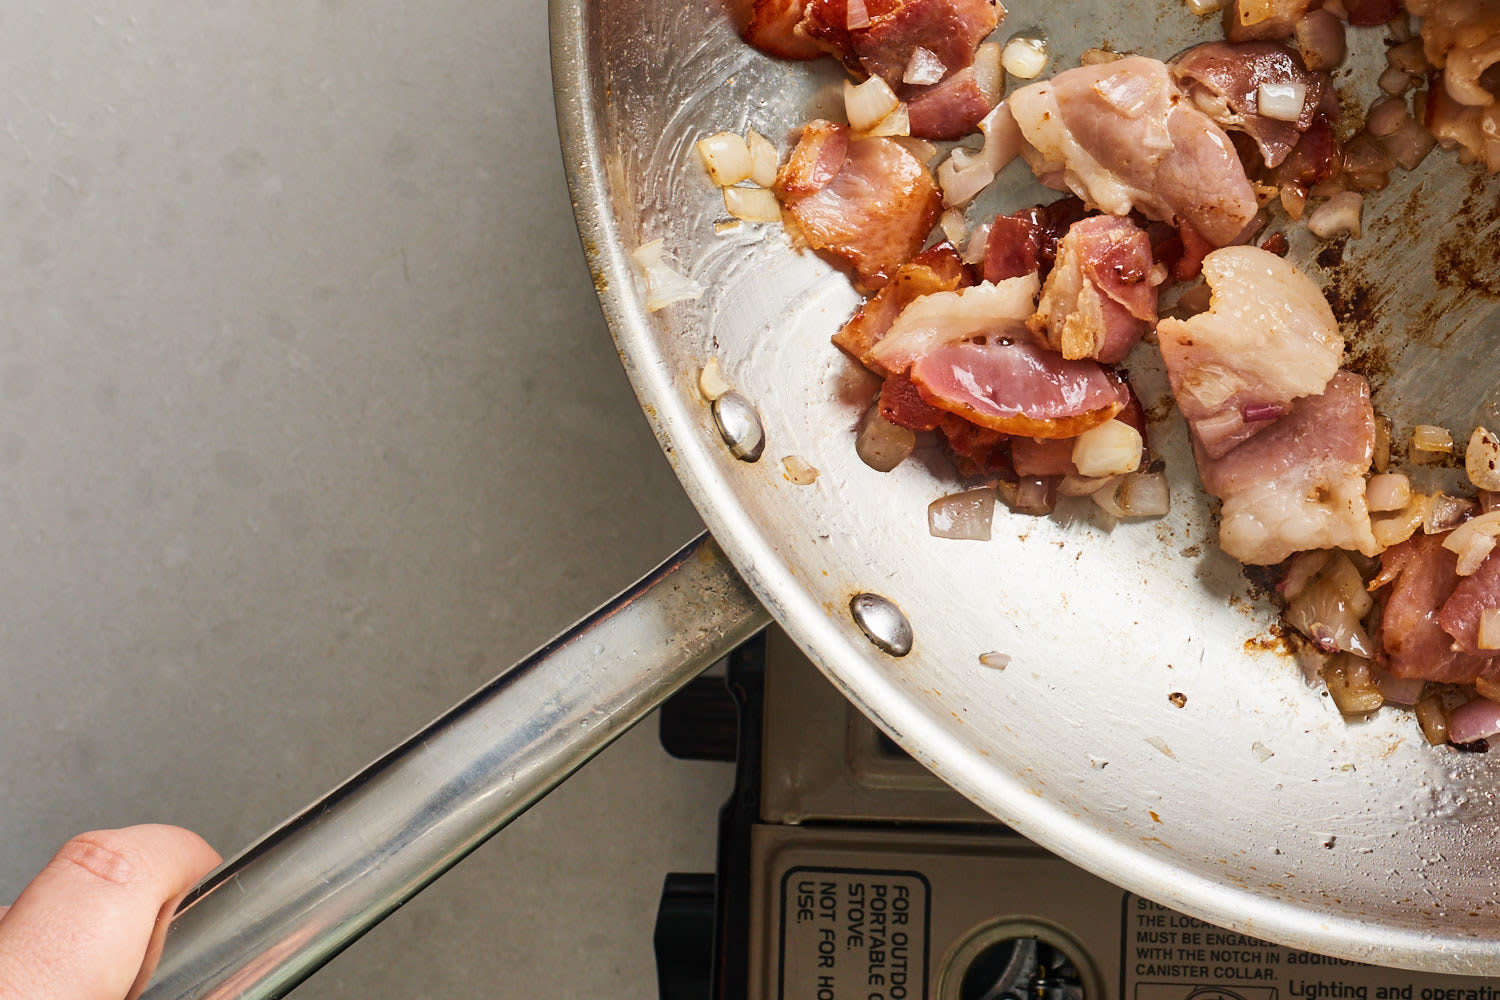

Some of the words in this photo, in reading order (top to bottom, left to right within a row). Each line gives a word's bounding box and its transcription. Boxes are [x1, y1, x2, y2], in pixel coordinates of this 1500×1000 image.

[797, 881, 815, 924] USE.
[819, 882, 837, 922] NOT
[847, 883, 865, 950] STOVE.
[892, 885, 910, 925] FOR
[1136, 915, 1166, 927] THE
[818, 928, 836, 968] FOR
[868, 884, 887, 986] PORTABLE
[1136, 931, 1178, 944] MUST
[1181, 932, 1201, 945] BE
[1135, 964, 1209, 978] CANISTER
[1213, 966, 1278, 981] COLLAR.
[1136, 948, 1173, 960] WITH
[1177, 949, 1206, 962] THE
[1210, 950, 1262, 963] NOTCH
[1266, 952, 1280, 965] IN
[1289, 980, 1367, 1000] Lighting
[1376, 983, 1412, 1000] and
